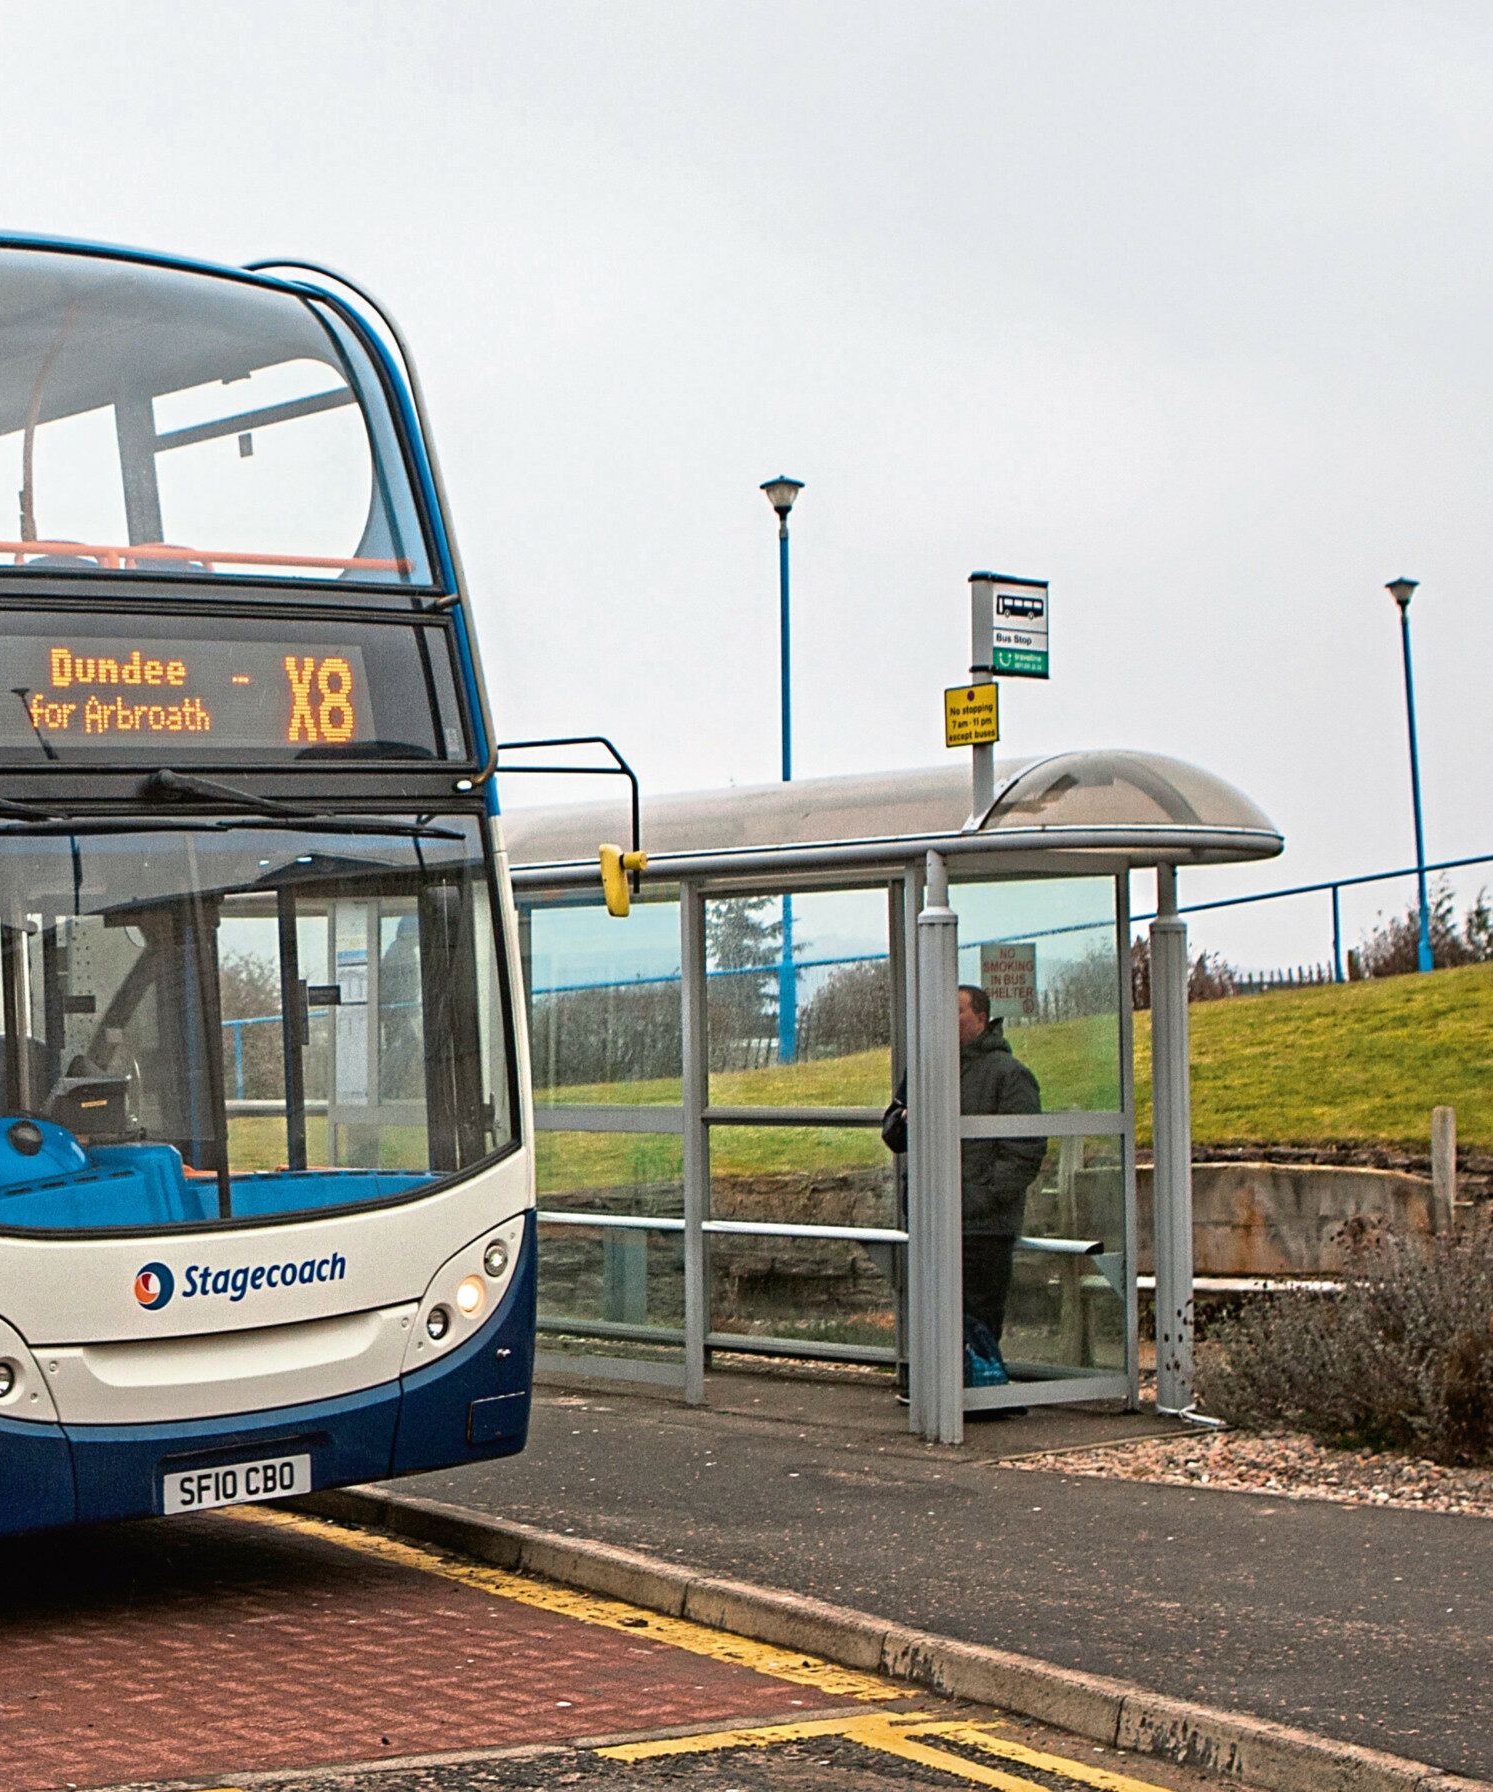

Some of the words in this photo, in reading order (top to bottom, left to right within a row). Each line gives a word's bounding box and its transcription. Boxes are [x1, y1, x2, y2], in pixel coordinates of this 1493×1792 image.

[996, 632, 1012, 643] Bus
[1014, 634, 1033, 646] Stop
[50, 647, 187, 688] Dundee
[284, 656, 355, 742] X8
[29, 693, 76, 729] for
[85, 694, 211, 734] Arbroath
[950, 706, 960, 716] No
[962, 703, 994, 715] stopping
[949, 731, 973, 742] except
[974, 729, 996, 739] buses
[999, 947, 1016, 959] NO
[983, 960, 1034, 973] SMOKING
[990, 974, 1001, 986] IN
[1003, 973, 1026, 986] BUS
[984, 986, 1034, 999] SHELTER
[181, 1251, 347, 1303] Stagecoach
[179, 1470, 238, 1506] SF10
[244, 1461, 295, 1495] CBO
